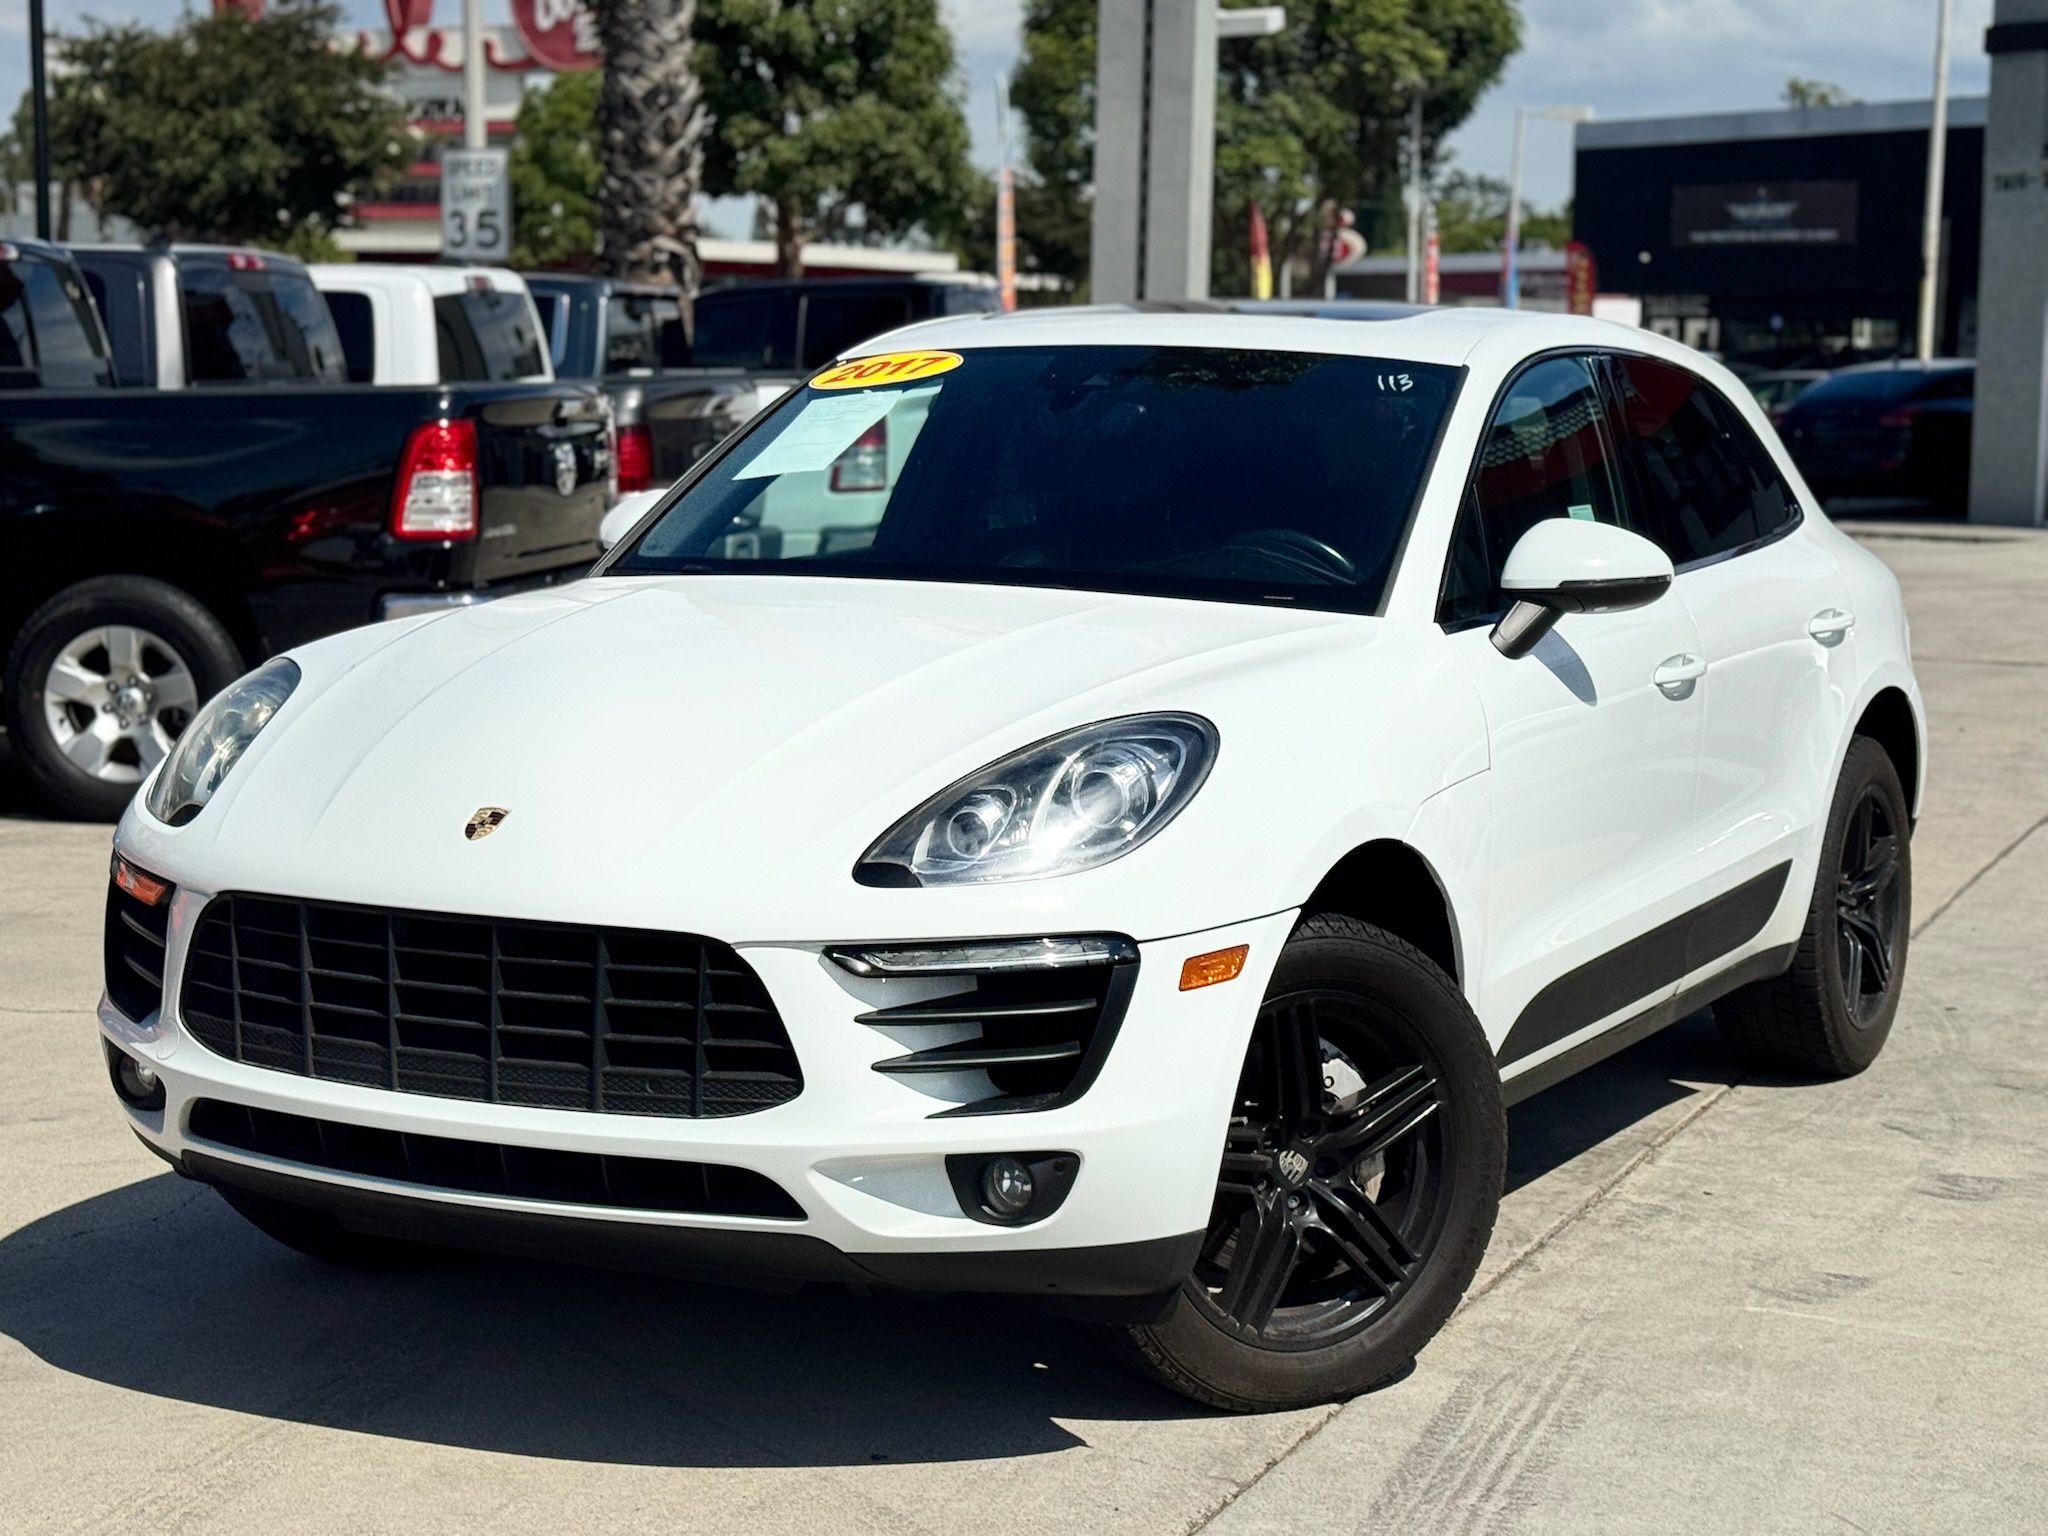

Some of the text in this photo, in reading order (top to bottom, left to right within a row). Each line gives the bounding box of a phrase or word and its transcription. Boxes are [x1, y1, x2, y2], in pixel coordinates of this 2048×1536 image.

[449, 158, 497, 177] SPEED
[451, 184, 494, 202] LIMIT
[449, 209, 500, 249] 35
[820, 356, 951, 385] 2017
[1377, 373, 1414, 392] 113
